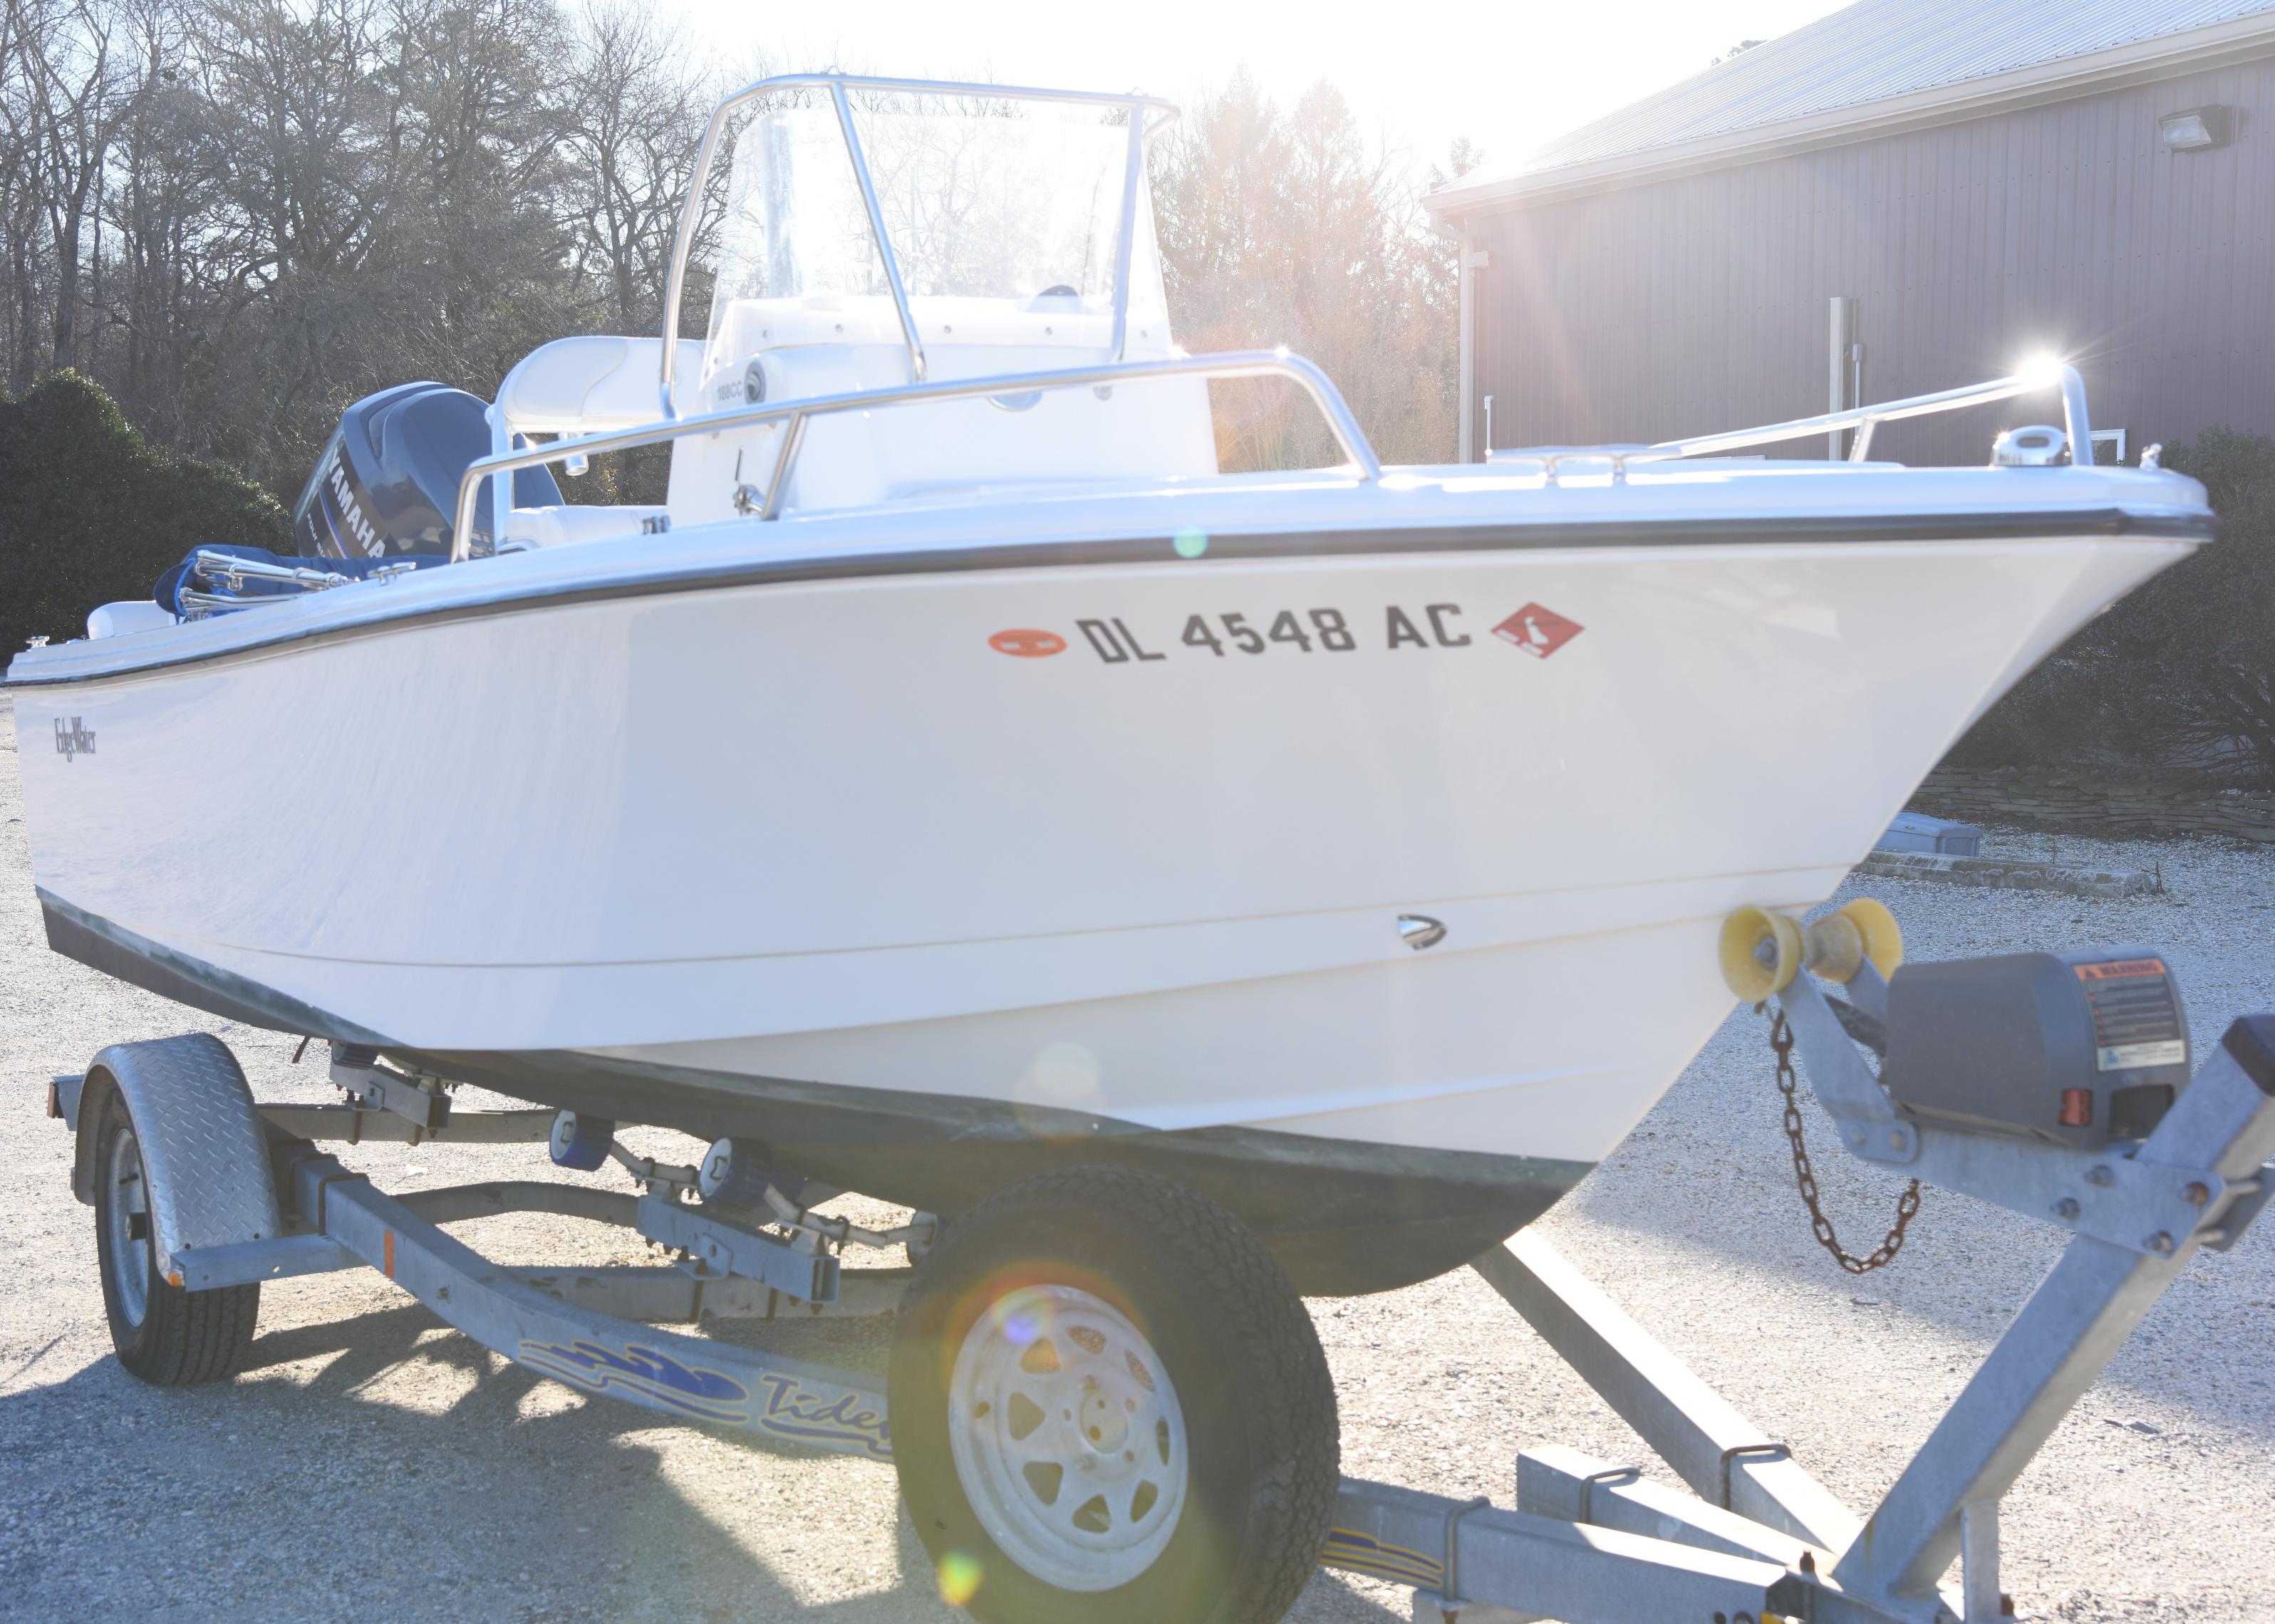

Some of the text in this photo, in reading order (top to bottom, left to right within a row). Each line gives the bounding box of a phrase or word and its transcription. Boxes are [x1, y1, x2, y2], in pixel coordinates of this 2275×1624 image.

[329, 447, 386, 558] YAMAHA
[1074, 603, 1472, 663] DL 4548 AC
